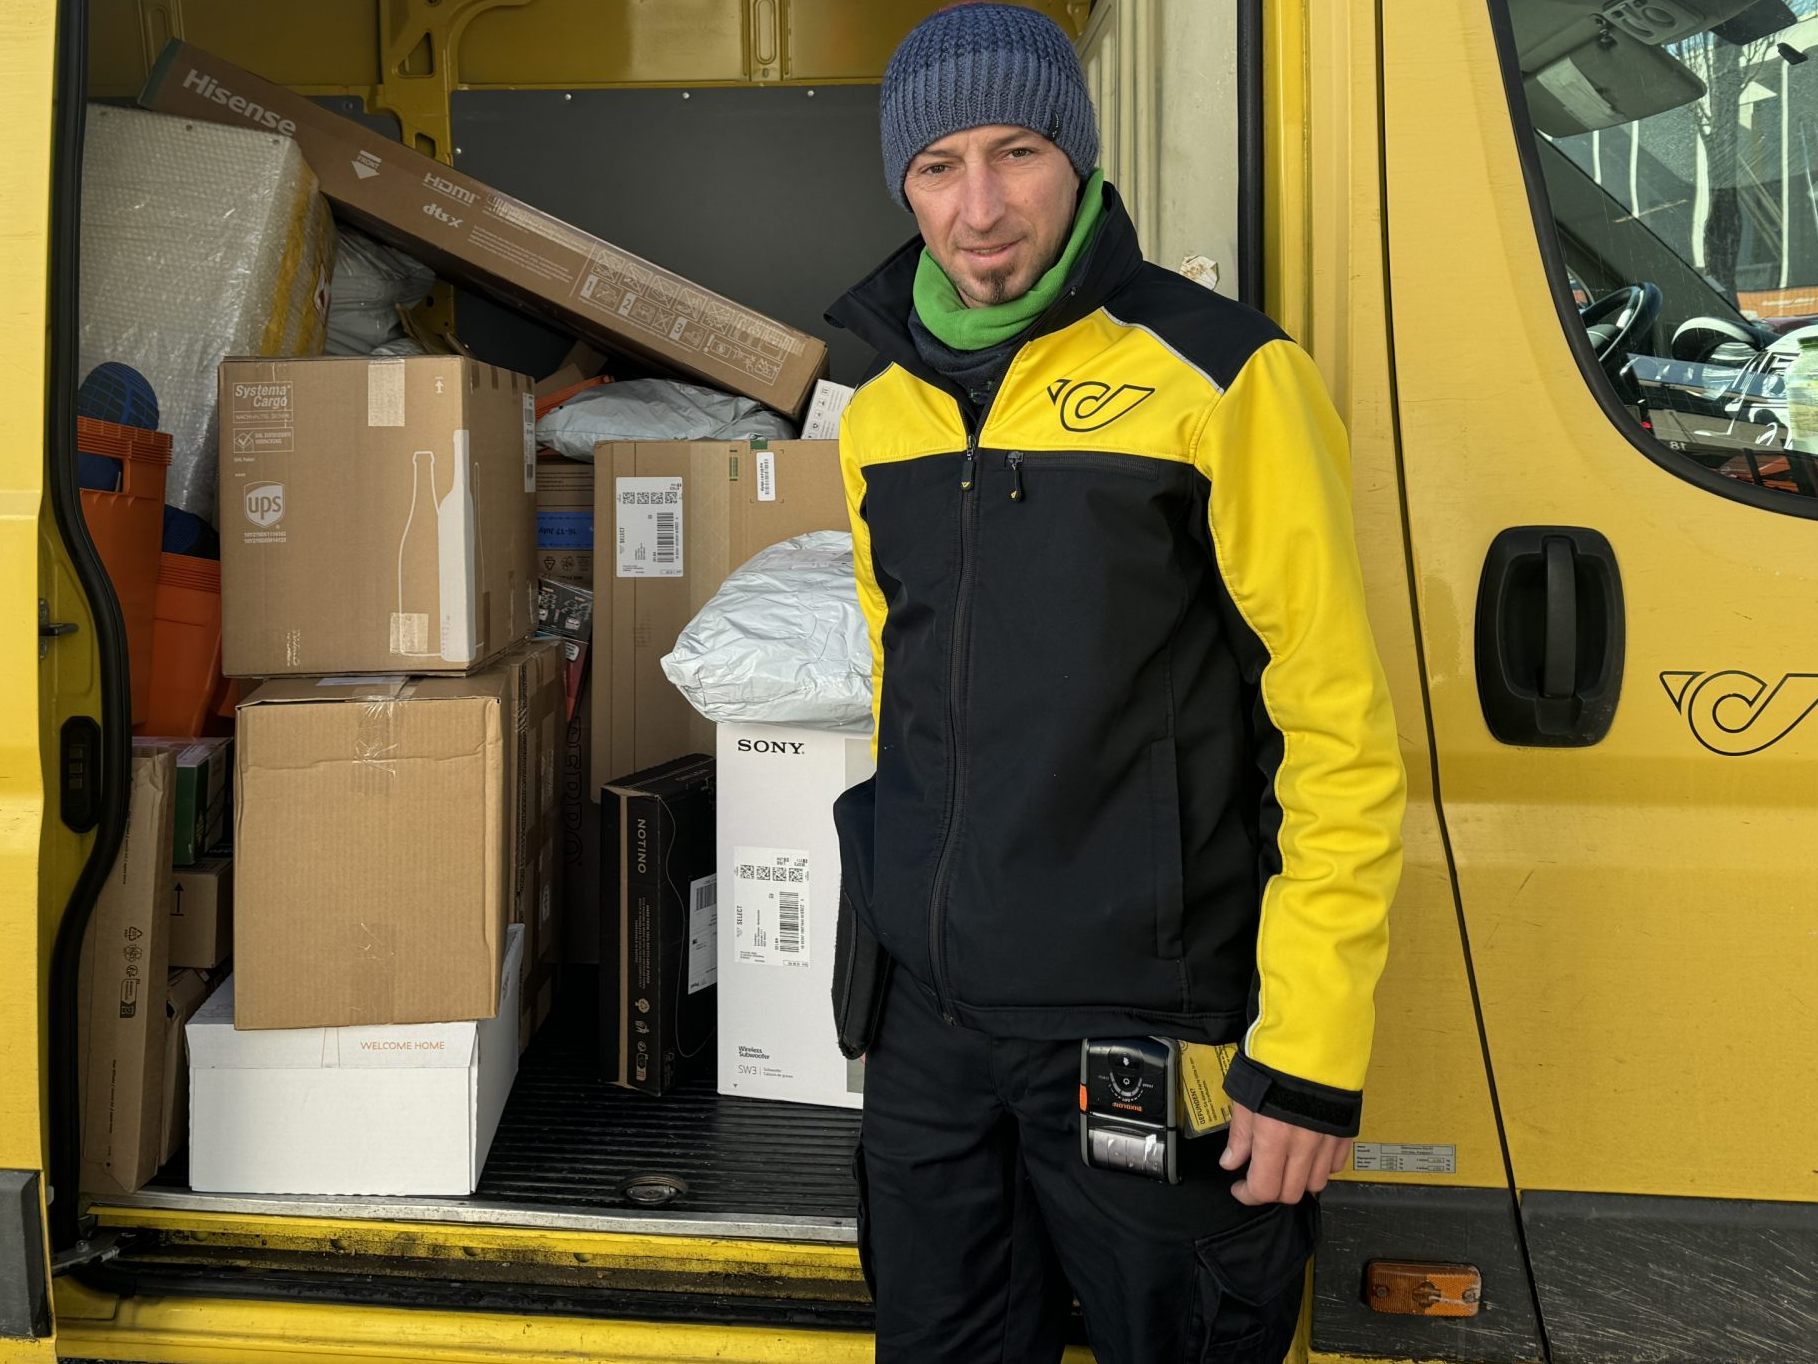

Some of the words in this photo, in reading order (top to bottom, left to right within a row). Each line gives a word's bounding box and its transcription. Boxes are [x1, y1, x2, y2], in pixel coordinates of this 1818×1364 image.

[182, 69, 296, 137] Hisense
[423, 172, 479, 204] HDMI
[235, 384, 287, 399] Systema
[254, 395, 288, 409] Cargo
[248, 496, 282, 521] ups
[737, 739, 805, 755] SONY
[637, 818, 648, 874] NOTINO
[360, 1041, 412, 1050] WELCOME
[414, 1041, 446, 1050] HOME
[738, 1045, 763, 1053] Wireless
[738, 1052, 770, 1060] Subwoofer
[738, 1064, 757, 1075] SW3
